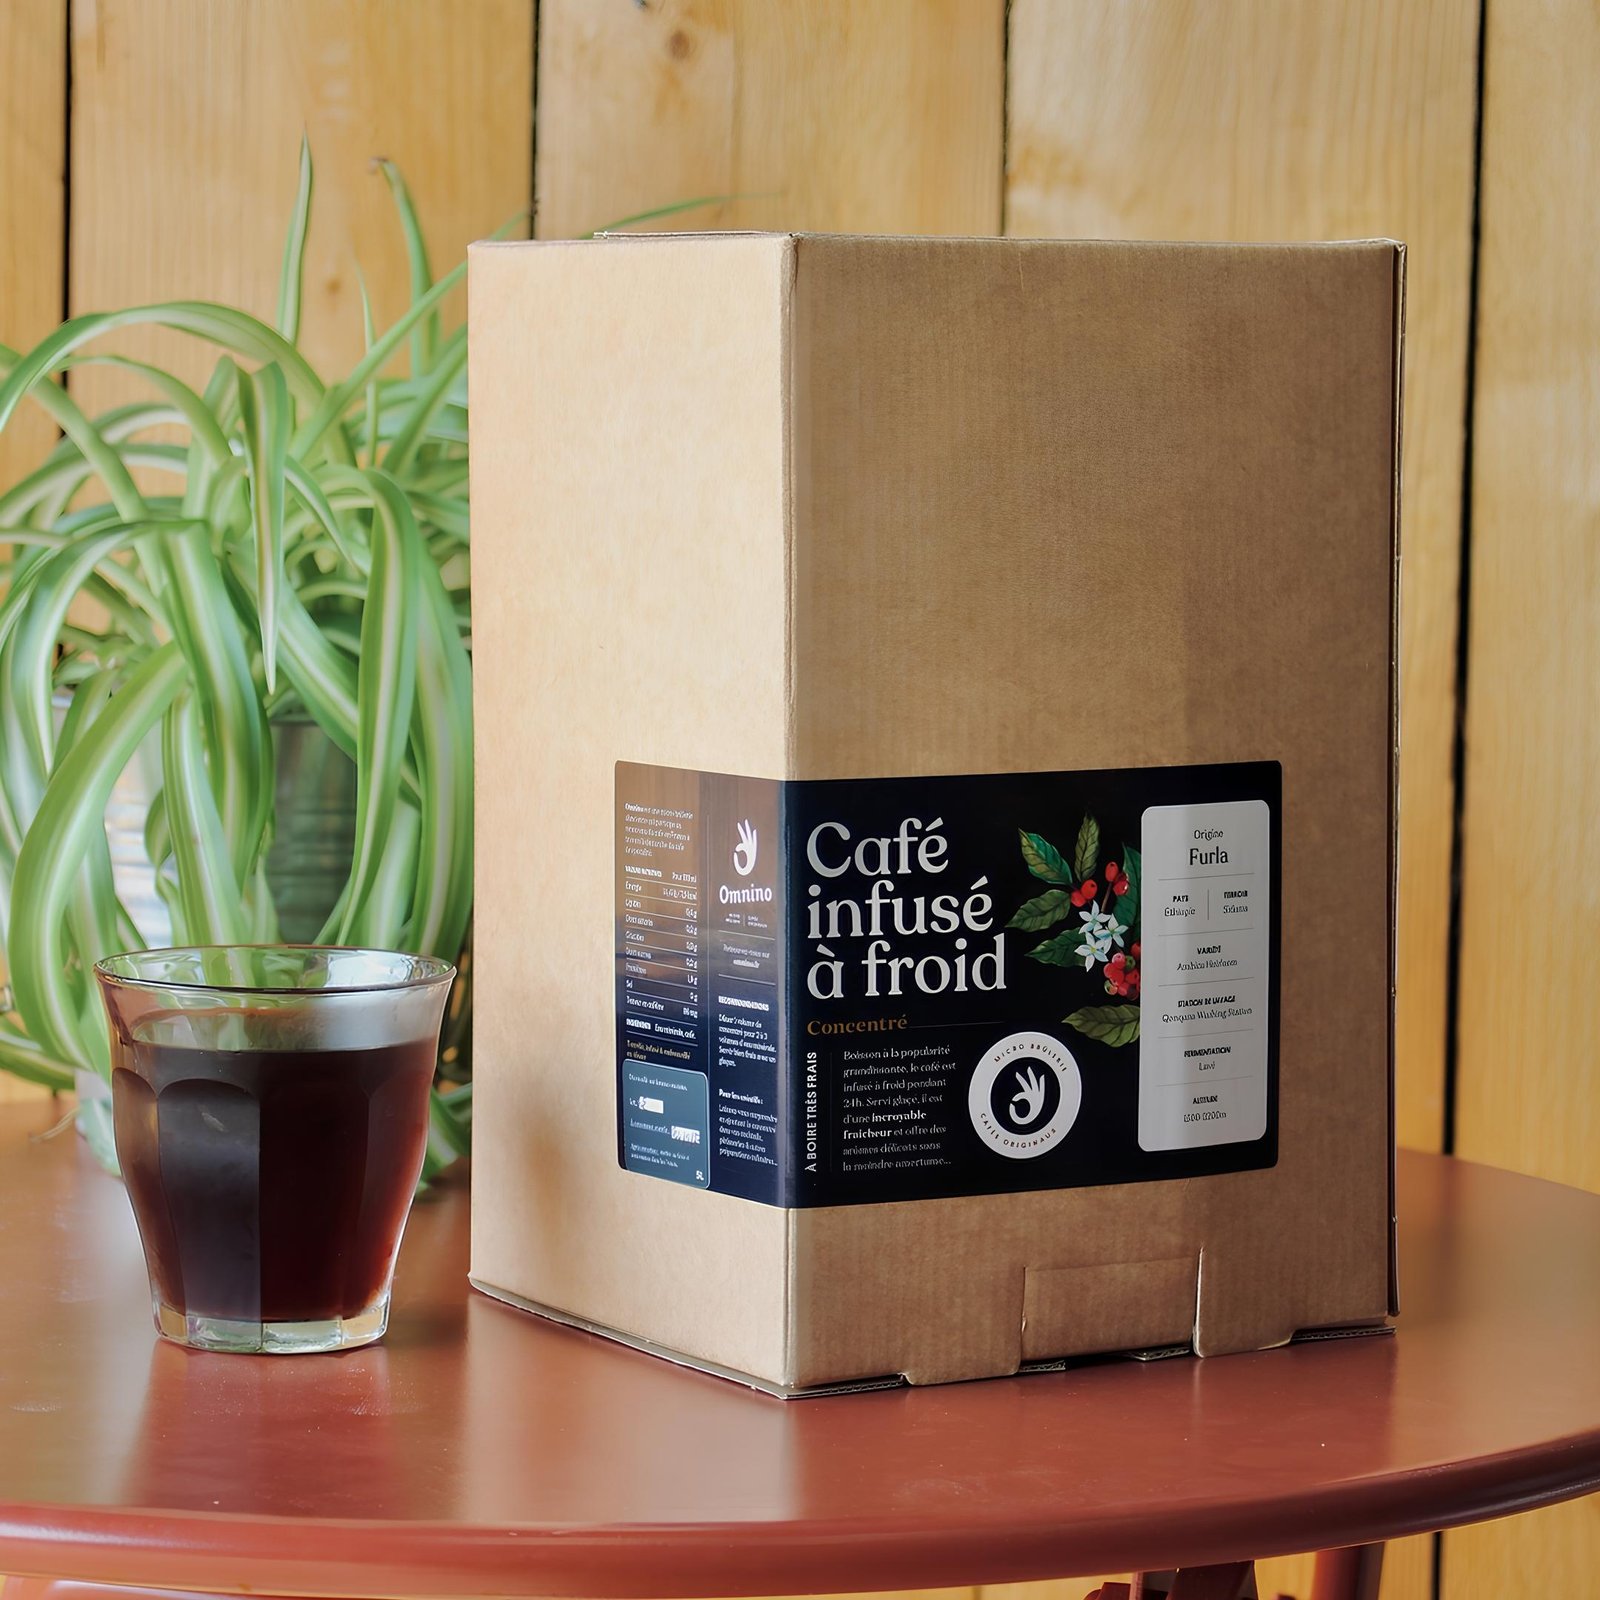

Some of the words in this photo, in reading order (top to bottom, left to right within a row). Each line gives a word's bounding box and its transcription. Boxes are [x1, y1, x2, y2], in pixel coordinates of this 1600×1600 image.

[807, 817, 949, 878] Café
[1189, 846, 1228, 866] Furla
[719, 883, 773, 904] Omnino
[808, 875, 993, 938] infusé
[807, 943, 844, 1000] à
[861, 933, 1007, 996] froid
[807, 1014, 908, 1036] Concentré
[806, 1051, 817, 1088] FRAIS
[805, 1091, 817, 1120] TRÈS
[872, 1108, 926, 1124] incroyable
[806, 1122, 817, 1160] BOIRE
